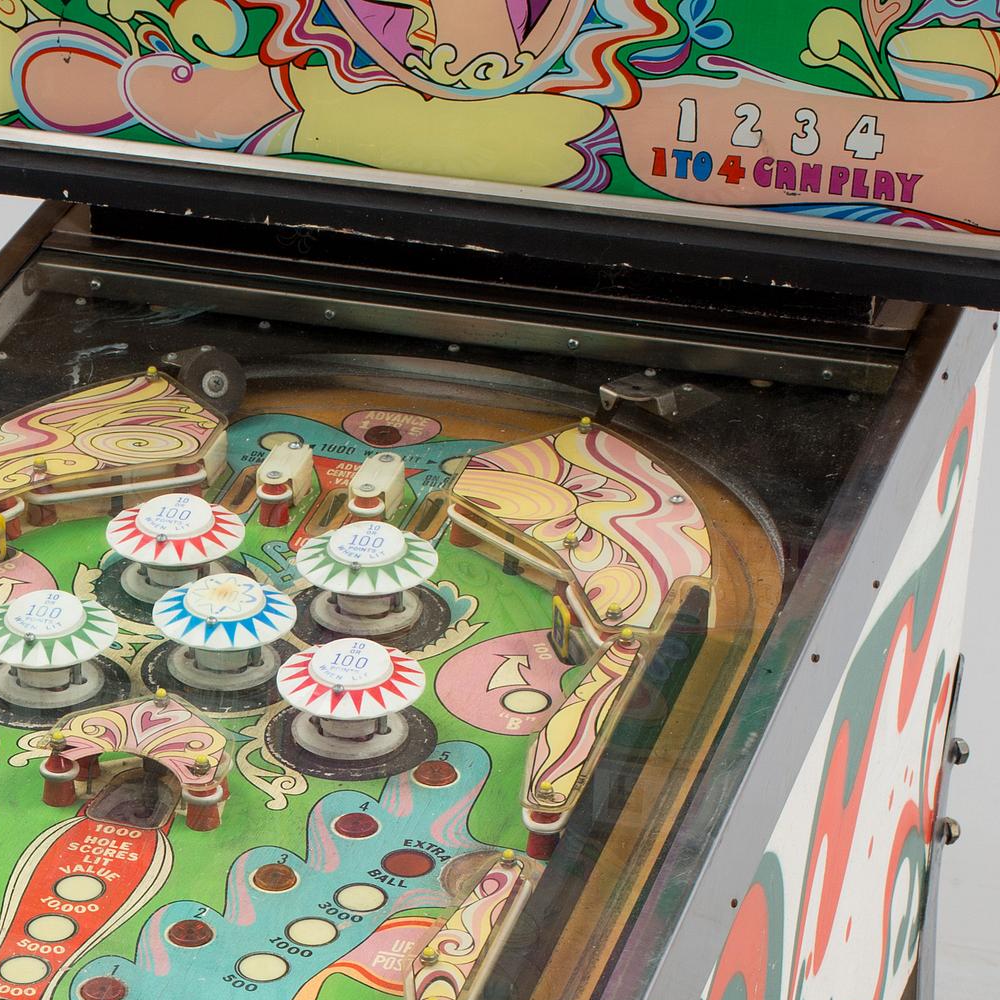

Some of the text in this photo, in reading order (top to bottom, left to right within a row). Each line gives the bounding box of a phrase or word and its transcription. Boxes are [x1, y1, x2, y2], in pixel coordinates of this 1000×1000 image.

[677, 98, 885, 160] 1 2 3 4
[652, 147, 923, 203] 1 TO 4 CAN PLAY
[365, 411, 431, 427] ADVANCE
[321, 443, 356, 455] 1000
[157, 507, 192, 520] 100
[348, 534, 385, 549] 100
[26, 604, 62, 619] 100
[532, 643, 552, 660] 100
[331, 653, 368, 669] 100
[439, 751, 450, 761] 5
[358, 801, 370, 812] 4
[94, 823, 142, 838] 1000
[83, 835, 133, 851] HOLE
[403, 839, 452, 862] EXTRA
[67, 842, 139, 862] SCORES
[83, 854, 114, 866] LIT
[277, 854, 289, 865] 3
[58, 865, 121, 882] VALUE
[367, 869, 408, 888] BALL
[40, 895, 100, 914] 10,000
[318, 901, 363, 923] 3000
[193, 907, 208, 919] 2
[16, 938, 66, 954] 5000
[269, 936, 313, 958] 1000
[110, 964, 121, 975] 1
[372, 955, 403, 971] POS
[222, 974, 258, 992] 500
